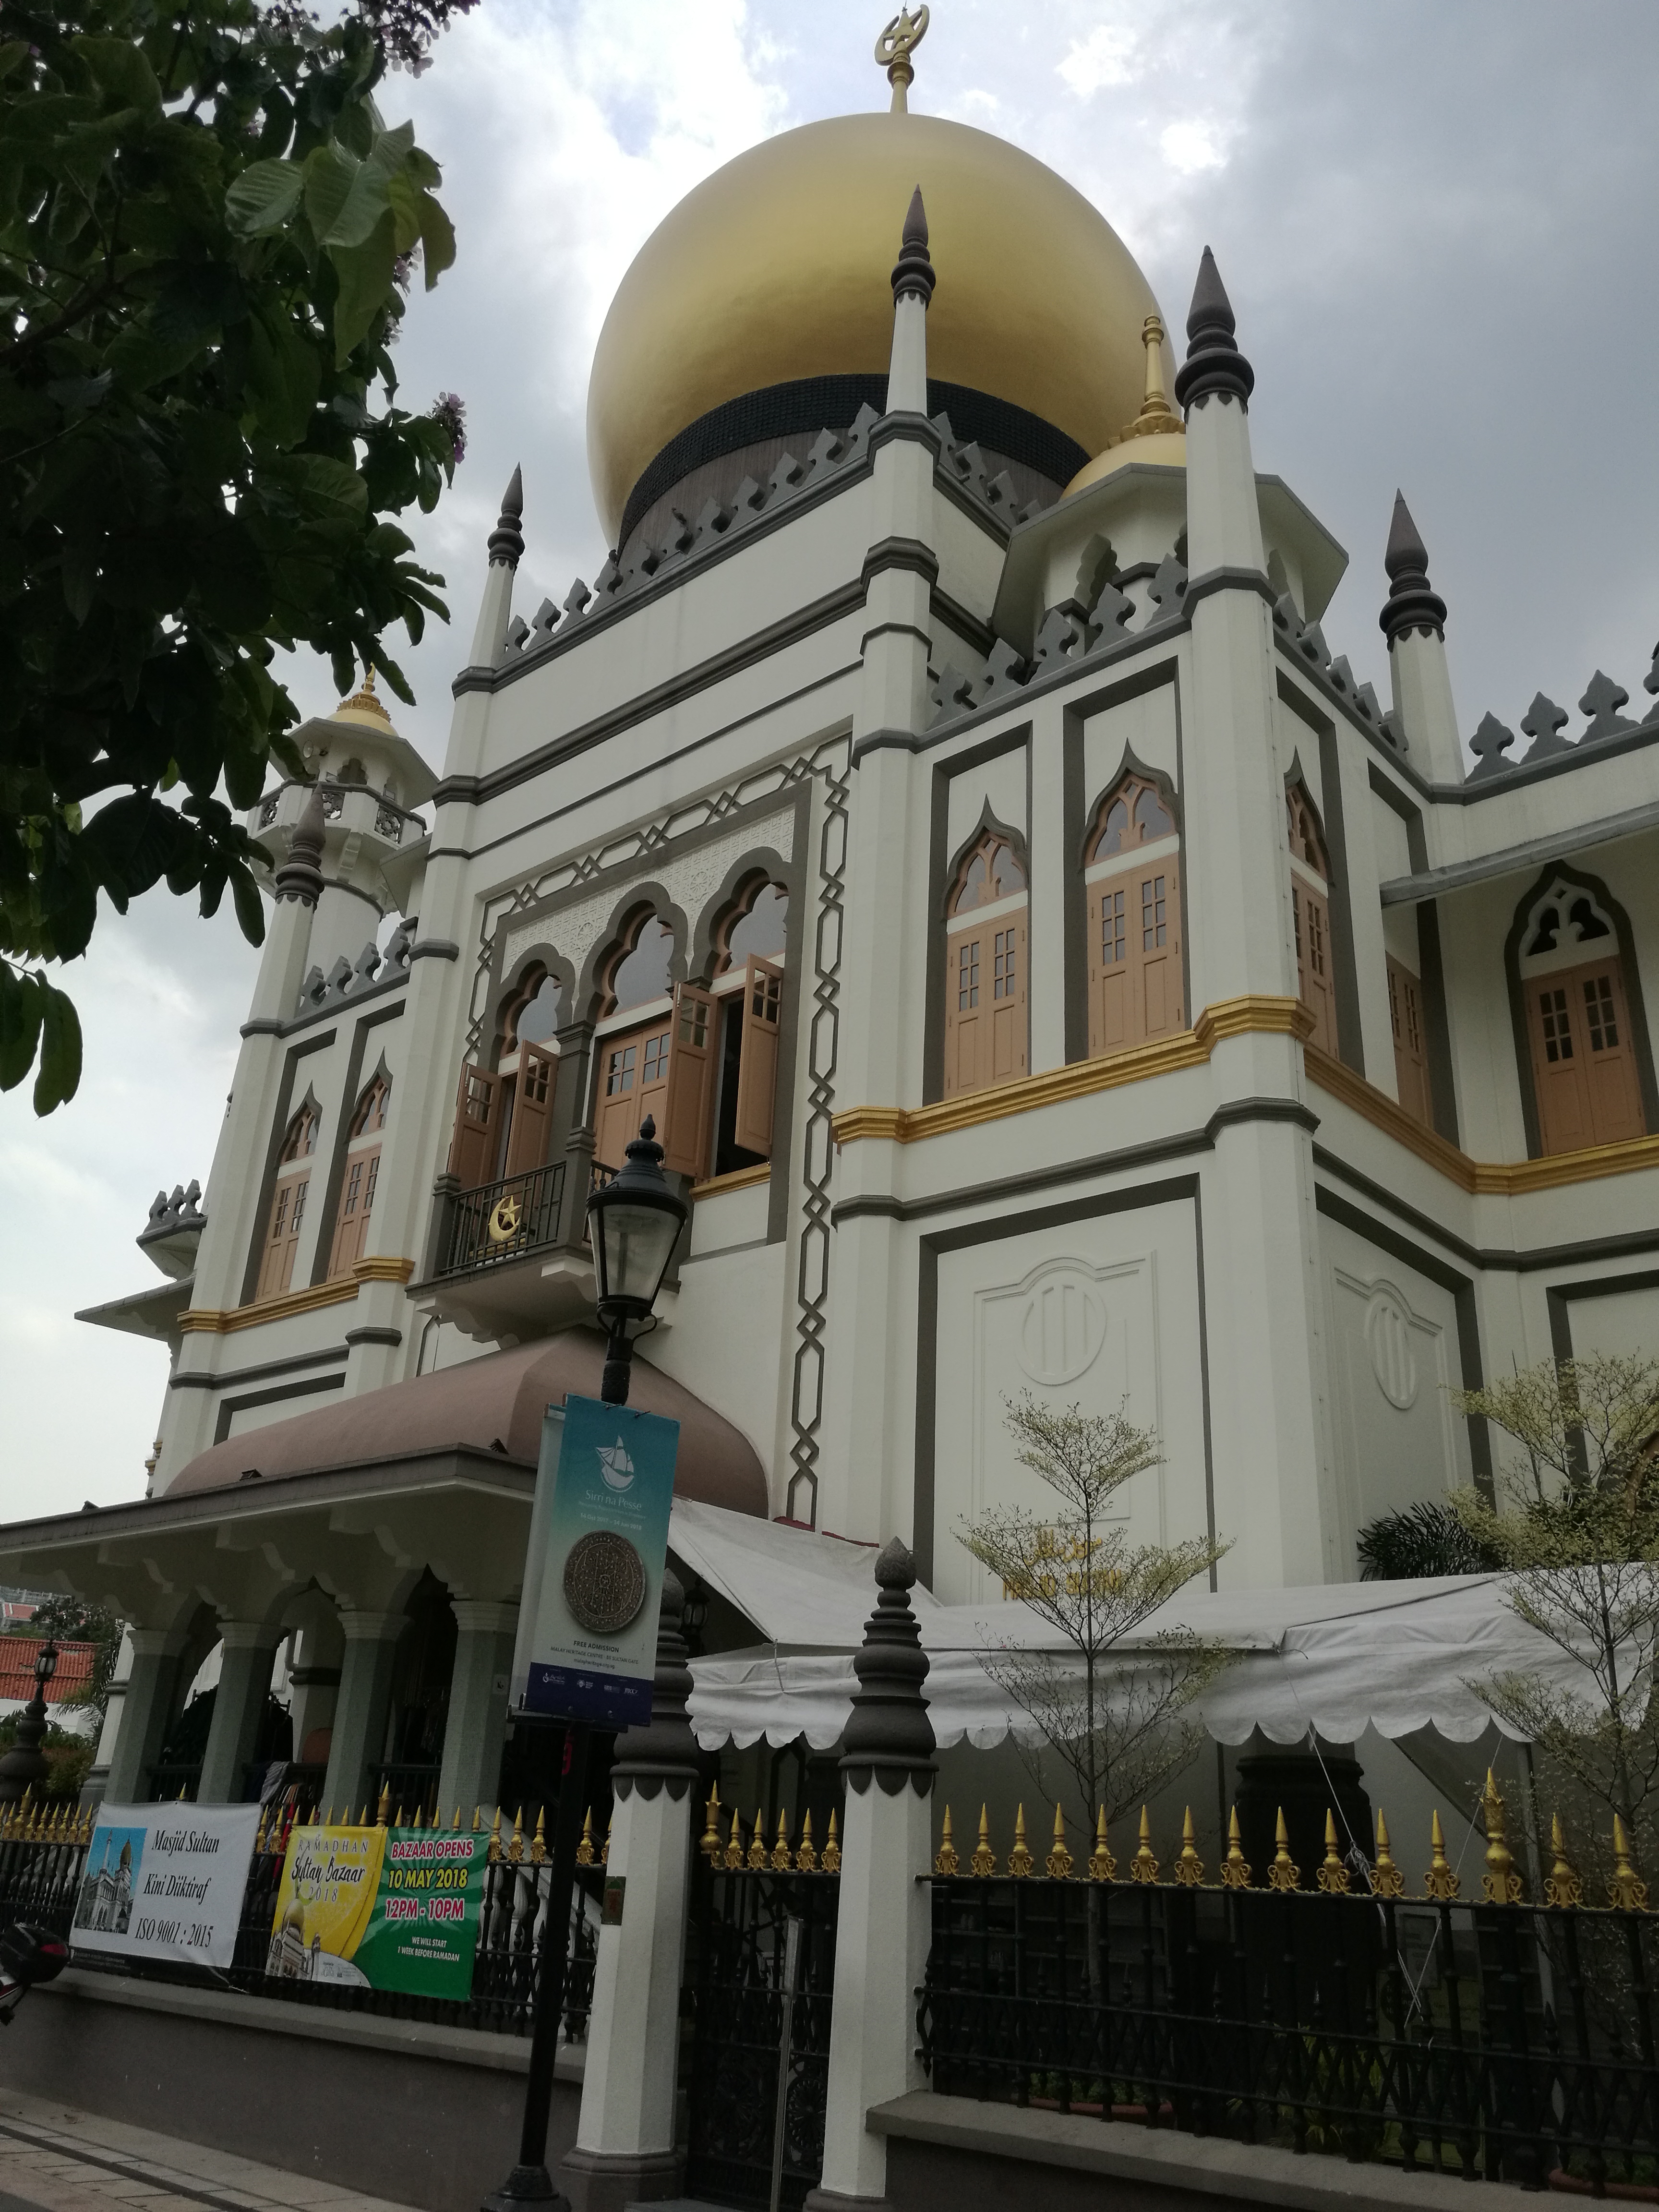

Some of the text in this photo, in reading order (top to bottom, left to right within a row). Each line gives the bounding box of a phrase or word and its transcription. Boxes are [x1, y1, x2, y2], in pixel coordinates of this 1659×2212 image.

[586, 1490, 603, 1502] Sirri
[606, 1497, 616, 1505] na
[618, 1497, 641, 1511] Pesse
[566, 1648, 586, 1656] HERITAGE
[588, 1643, 619, 1653] ADMISSION
[152, 1830, 219, 1857] Masjid Sultan
[298, 1839, 368, 1852] RAMADHAN
[391, 1840, 473, 1859] BAZAAR OPENS
[291, 1856, 365, 1884] Sultan Bazaar
[389, 1868, 468, 1888] 10 MAY 2018
[143, 1874, 211, 1905] Kini Diiktiraf
[386, 1899, 418, 1919] 12PM
[429, 1899, 464, 1919] 10PM
[135, 1918, 155, 1940] ISO
[156, 1920, 181, 1943] 9001
[187, 1923, 214, 1948] 2015
[420, 1937, 431, 1946] WILL
[432, 1939, 447, 1948] START
[401, 1947, 414, 1955] WEEK
[414, 1949, 432, 1958] BEFORE
[433, 1951, 459, 1961] RAMADAN
